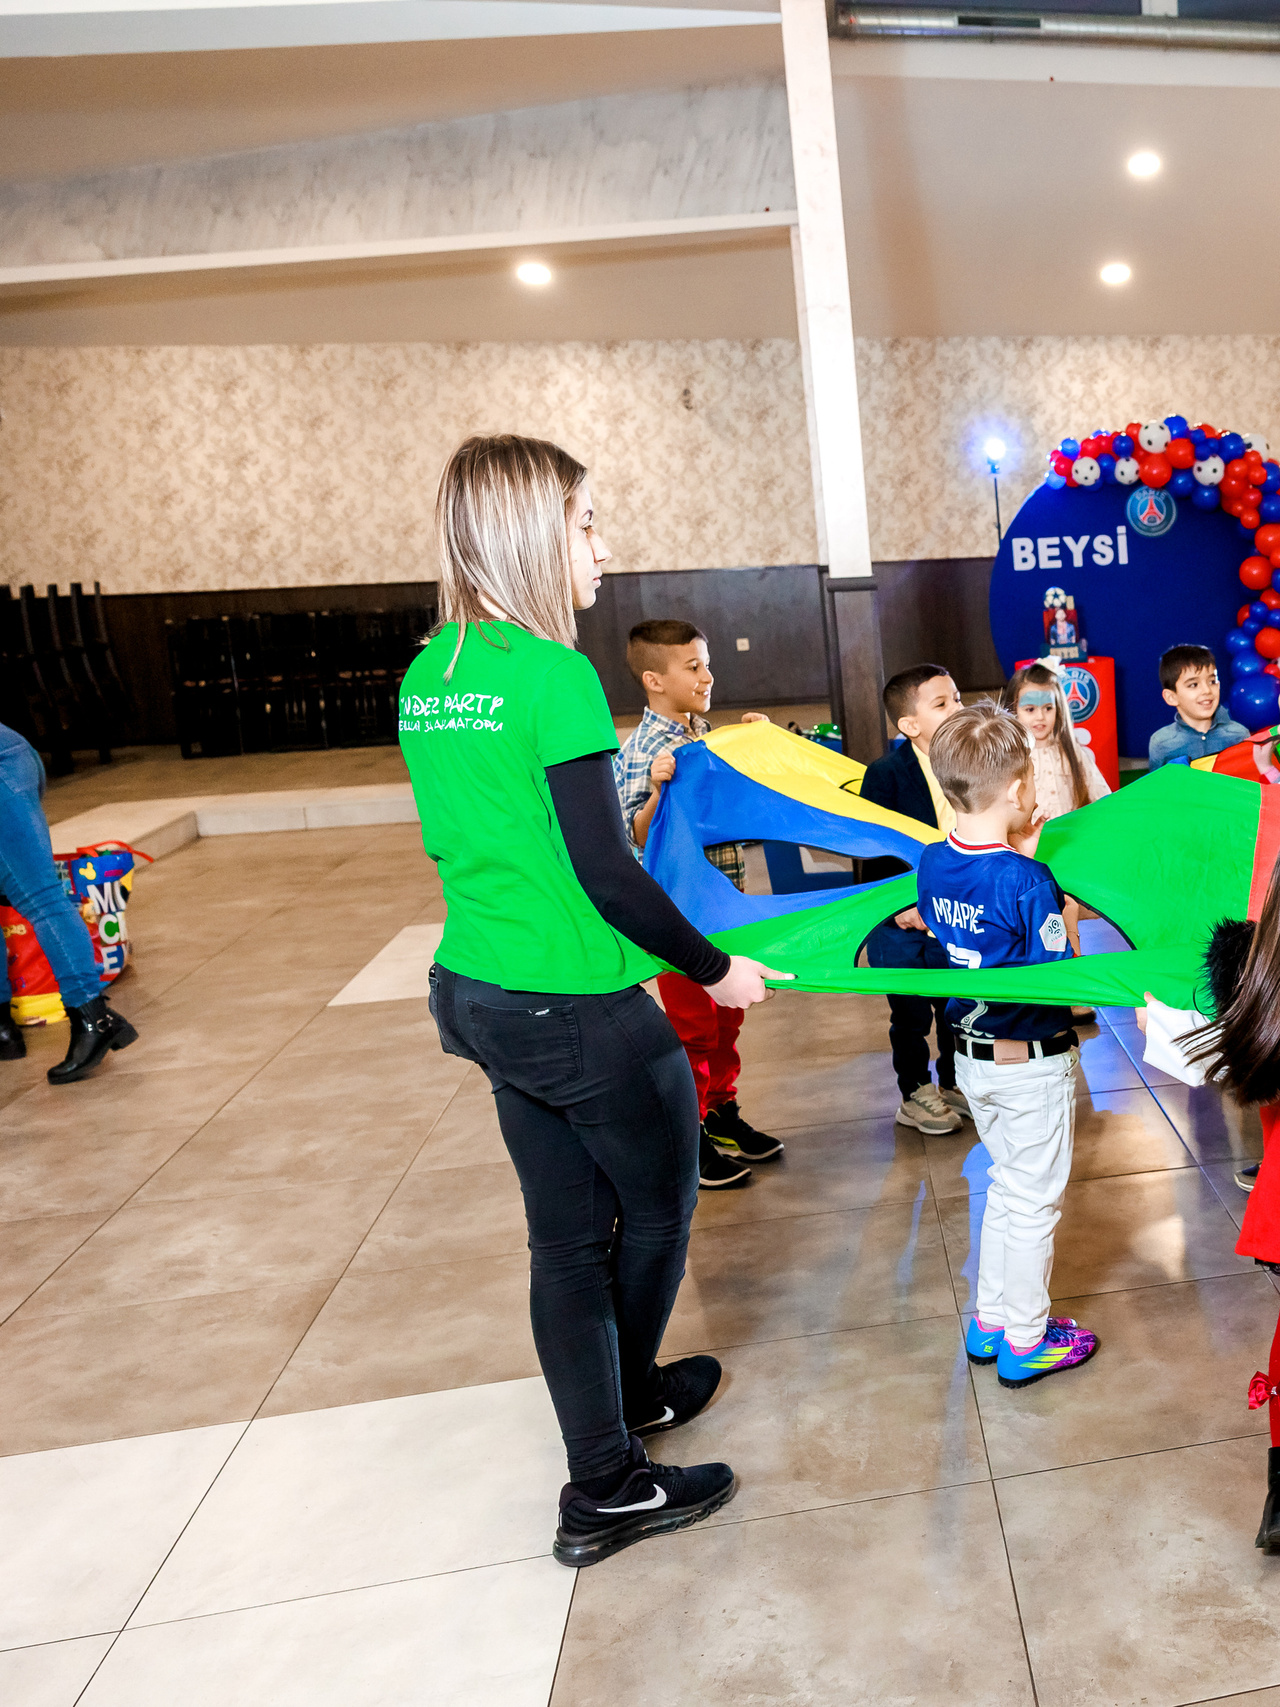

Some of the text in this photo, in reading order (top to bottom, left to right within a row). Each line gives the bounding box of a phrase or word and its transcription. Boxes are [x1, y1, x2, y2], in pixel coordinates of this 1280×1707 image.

[1135, 488, 1167, 501] PARIS
[1011, 526, 1129, 572] BEYSİ
[444, 693, 504, 716] PARTY
